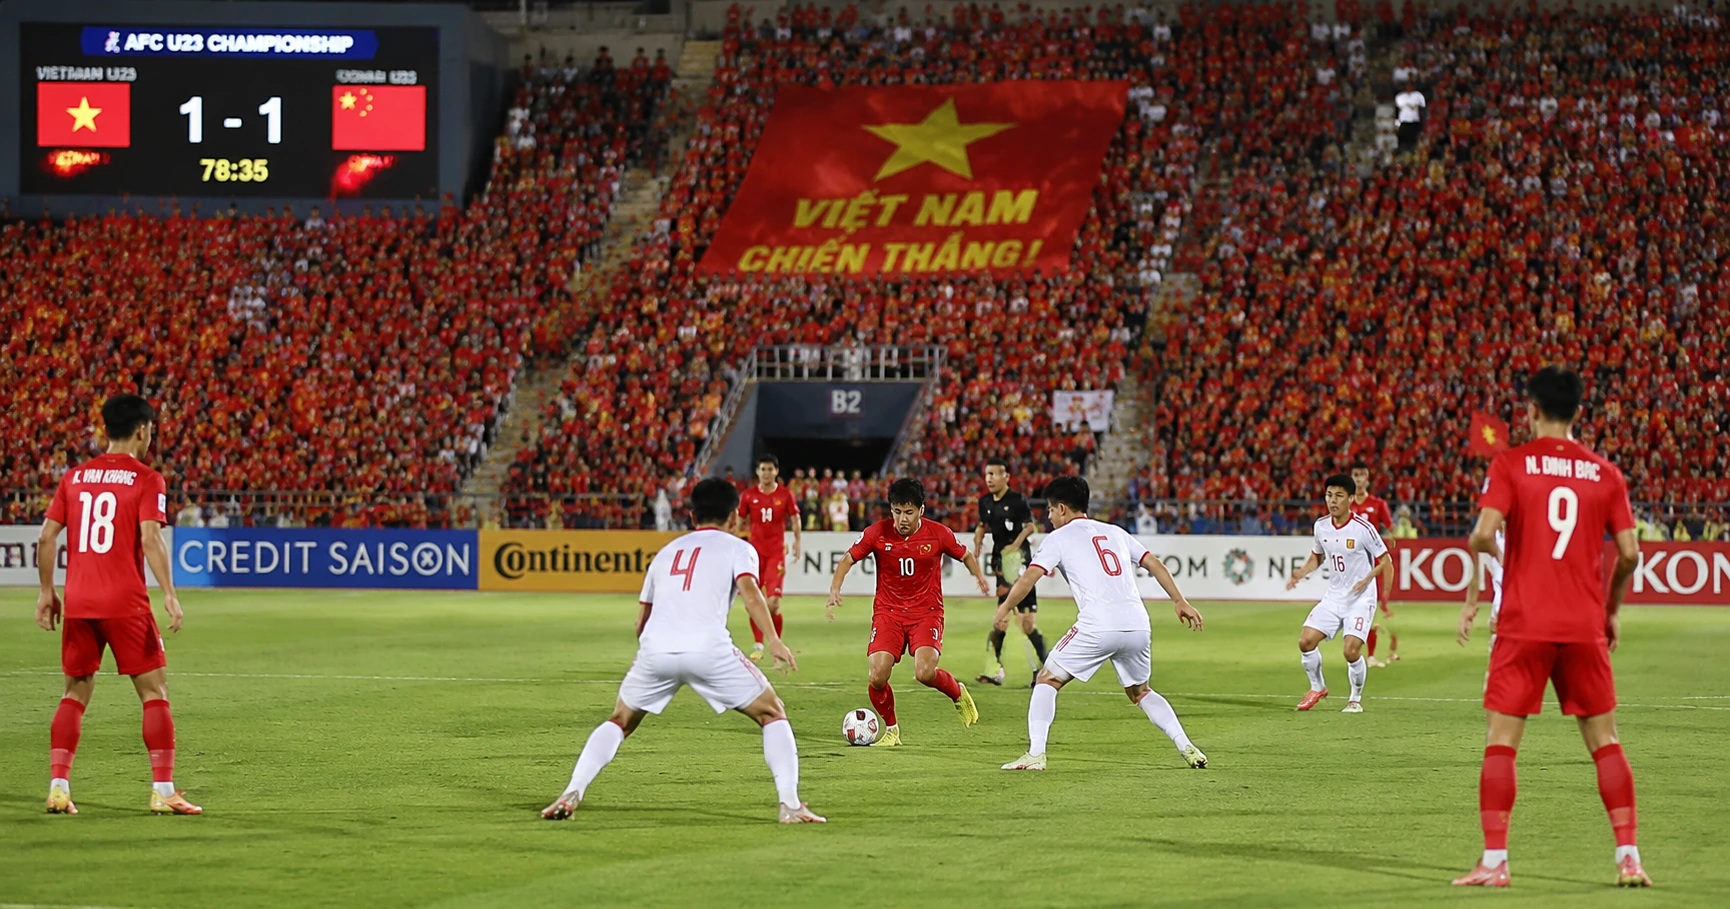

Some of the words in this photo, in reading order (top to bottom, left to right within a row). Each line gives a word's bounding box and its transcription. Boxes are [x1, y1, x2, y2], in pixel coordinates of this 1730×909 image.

[123, 33, 163, 52] AFC
[166, 33, 205, 52] U23
[206, 34, 354, 54] CHAMPIONSHIP
[179, 96, 203, 143] 1
[258, 96, 282, 144] 1
[200, 158, 269, 182] 78:35
[793, 189, 909, 234] VIỆT
[914, 189, 1039, 226] NAM
[832, 389, 862, 414] B2
[82, 469, 104, 484] VAN
[1525, 455, 1541, 475] N.
[78, 491, 117, 554] 18
[1547, 486, 1578, 560] 9
[179, 540, 316, 574] CREDIT
[329, 541, 470, 576] SAISON
[670, 547, 701, 591] 4
[898, 557, 915, 576] 10
[1092, 535, 1122, 577] 6
[1331, 554, 1345, 572] 16
